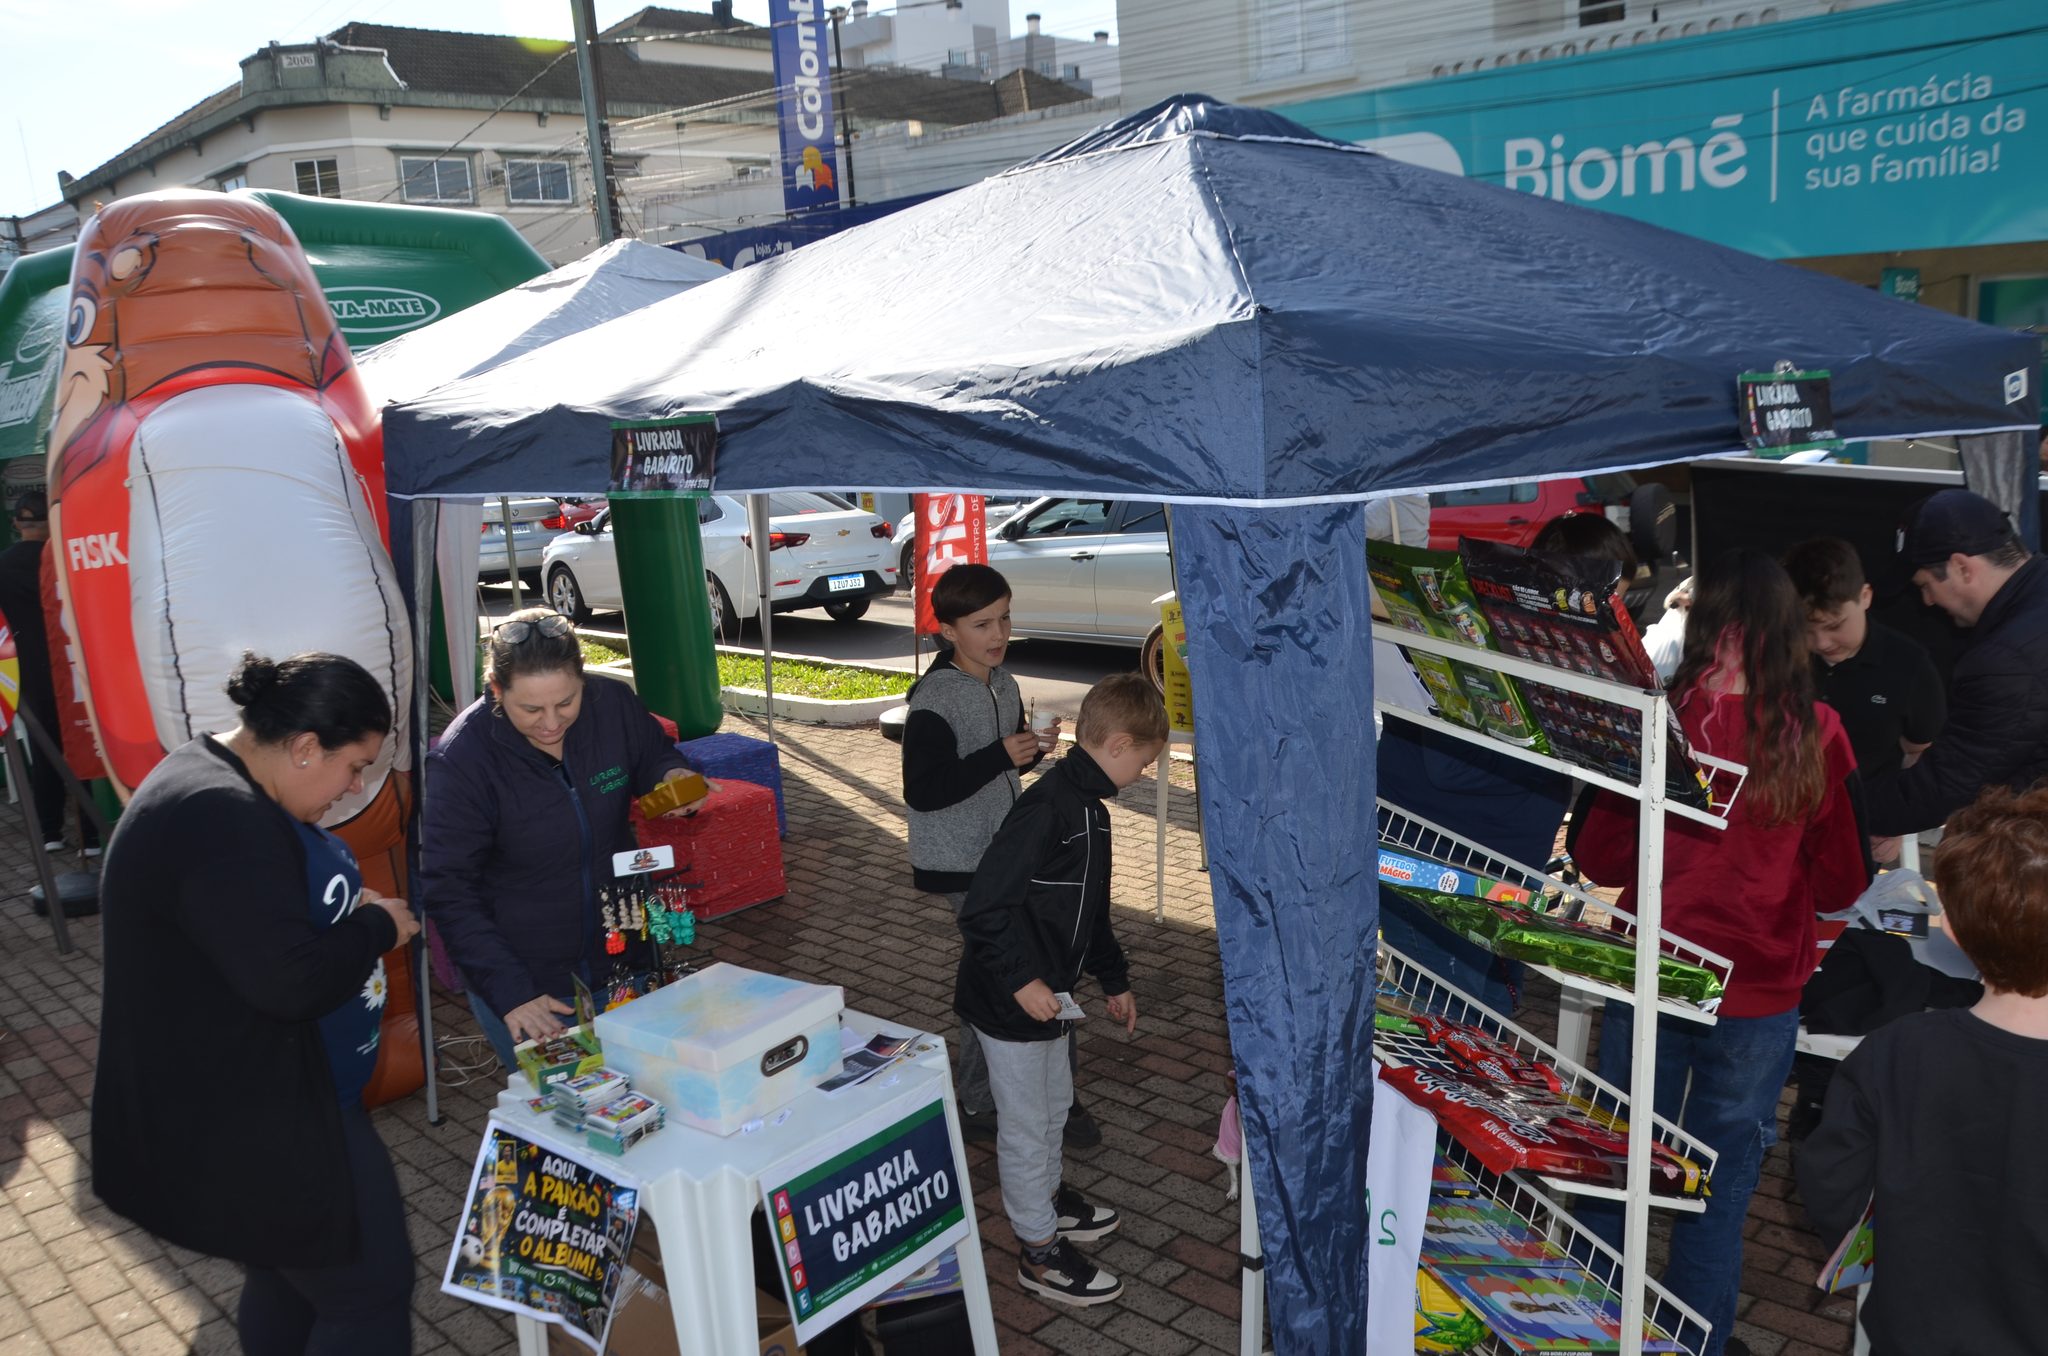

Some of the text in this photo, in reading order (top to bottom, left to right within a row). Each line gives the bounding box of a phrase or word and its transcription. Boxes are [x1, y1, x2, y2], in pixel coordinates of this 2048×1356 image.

[1806, 72, 1993, 122] A farmácia
[1806, 103, 2026, 162] que cuida da
[1805, 141, 2001, 190] sua família!
[635, 429, 684, 452] LIVRARIA
[643, 454, 694, 475] GABARITO
[970, 495, 979, 512] DE
[927, 493, 968, 575] FIS
[68, 532, 129, 571] FISK
[1379, 855, 1415, 871] FUTEBOL
[1379, 866, 1412, 880] MÁGICO
[541, 1156, 578, 1184] AQUI,
[524, 1172, 601, 1217] A PAIXÃO
[804, 1149, 920, 1236] LIVRARIA
[558, 1206, 567, 1221] É
[777, 1197, 788, 1212] A
[832, 1169, 949, 1262] GABARITO
[514, 1209, 607, 1257] COMPLETAR
[783, 1221, 791, 1236] B
[519, 1236, 534, 1257] O
[793, 1270, 802, 1285] D
[799, 1293, 808, 1311] E
